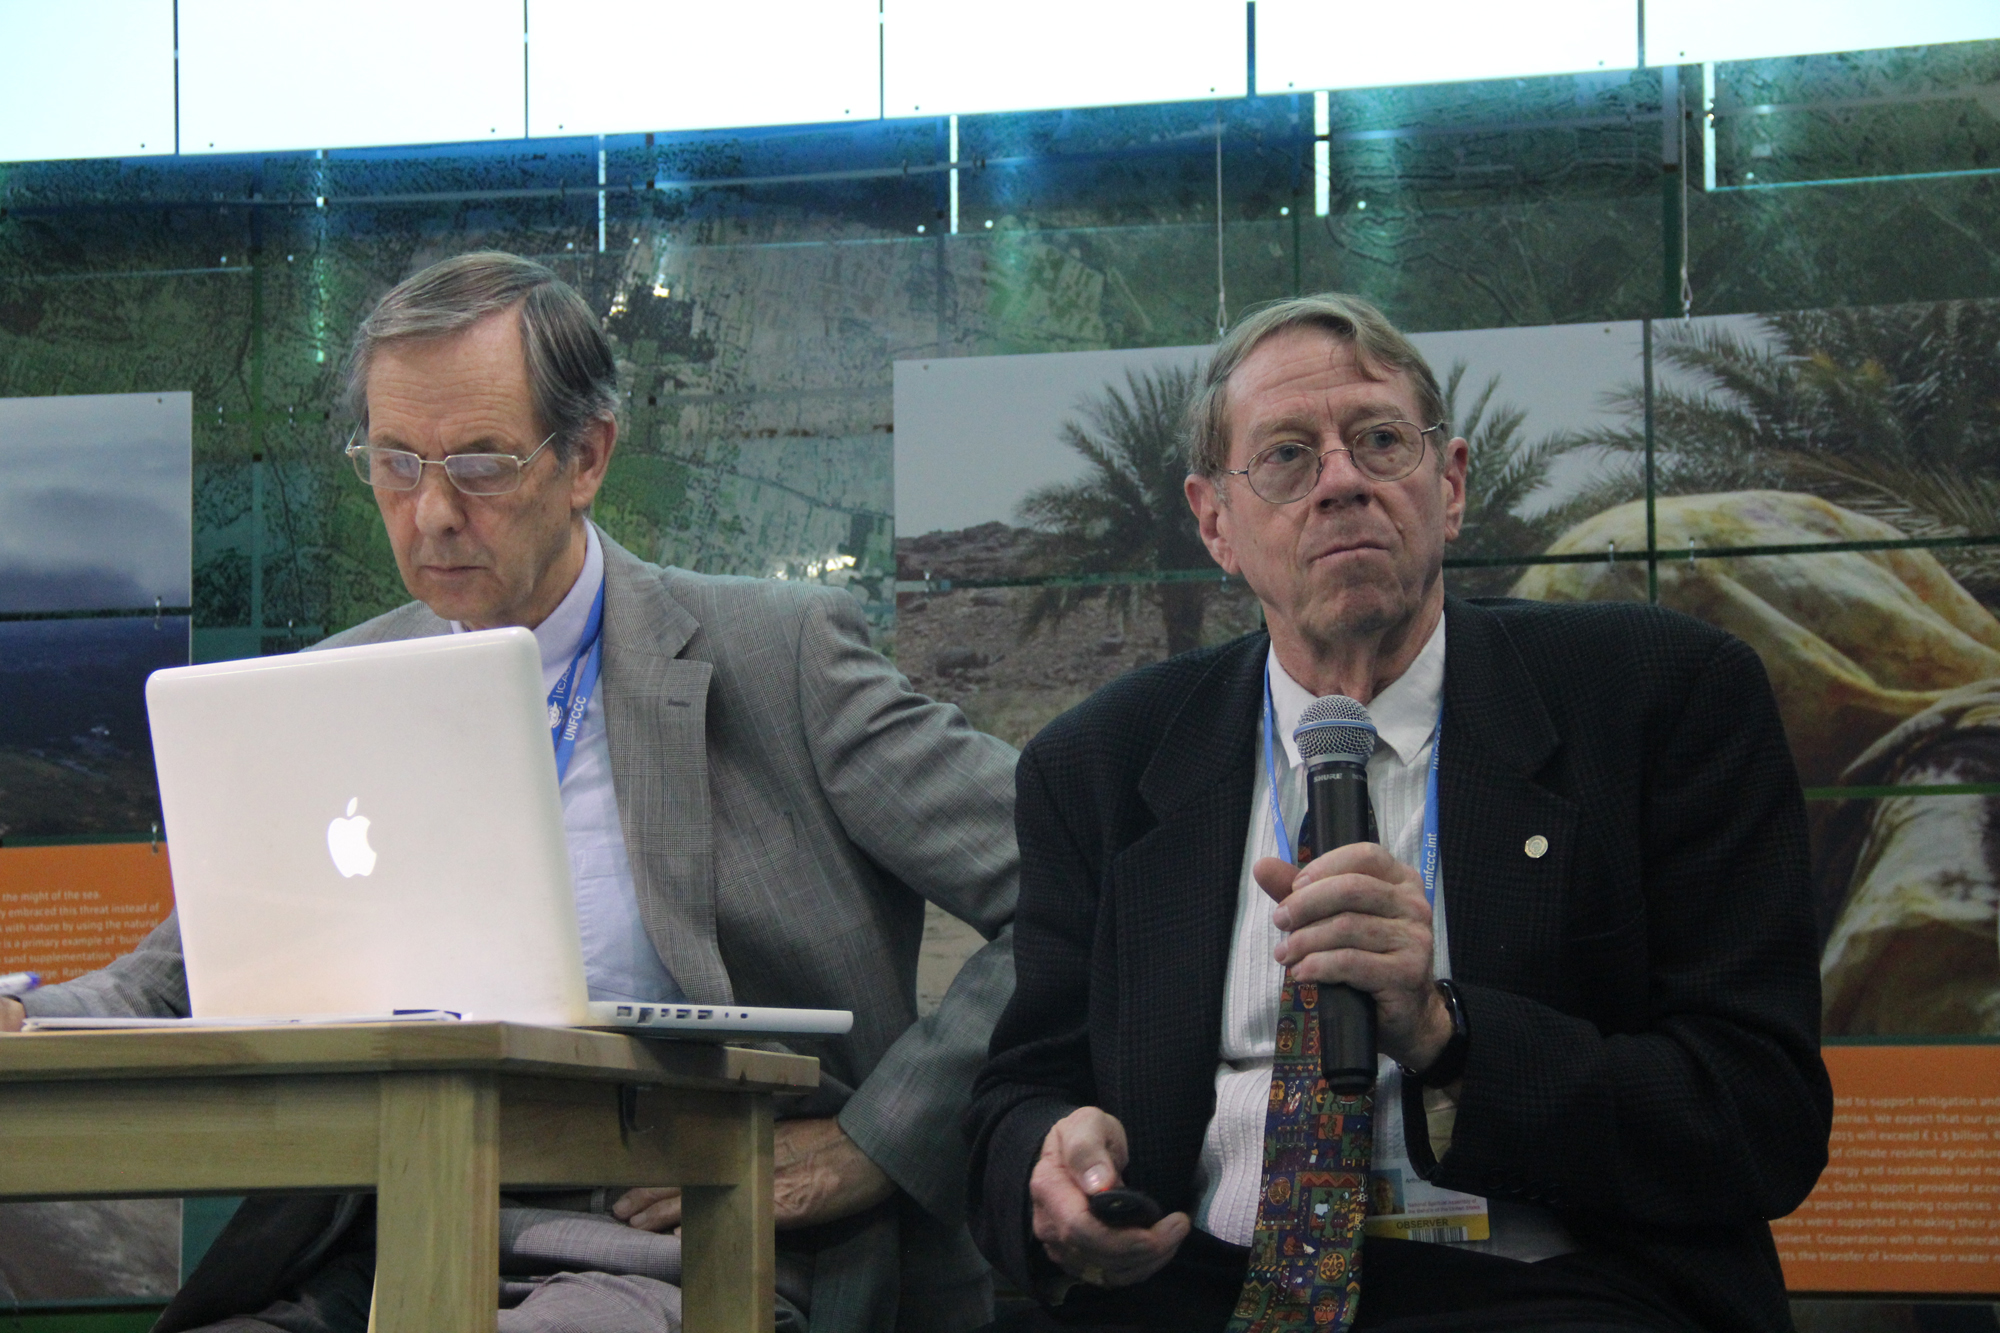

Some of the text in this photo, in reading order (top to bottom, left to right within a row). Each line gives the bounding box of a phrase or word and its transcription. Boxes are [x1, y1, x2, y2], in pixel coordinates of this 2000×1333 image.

[564, 696, 586, 740] UNFCCC
[1314, 773, 1342, 782] SHURE
[1424, 832, 1437, 890] unfccc.int
[2, 892, 18, 902] the
[20, 891, 49, 904] might
[51, 890, 62, 900] of
[64, 890, 80, 900] the
[8, 906, 57, 918] embraced
[59, 906, 78, 916] this
[80, 904, 109, 915] threat
[111, 902, 148, 914] instead
[149, 902, 160, 912] of
[4, 922, 26, 933] with
[28, 923, 60, 932] nature
[62, 921, 74, 932] by
[76, 920, 103, 932] using
[105, 920, 122, 930] the
[124, 918, 159, 929] natural
[4, 938, 12, 948] is
[14, 940, 20, 948] a
[22, 938, 59, 950] primary
[62, 936, 102, 947] example
[104, 934, 115, 945] of
[4, 954, 28, 964] sand
[1854, 1096, 1868, 1106] to
[1870, 1096, 1914, 1109] support
[1918, 1096, 1978, 1110] mitigation
[1874, 1114, 1892, 1124] We
[1894, 1114, 1934, 1126] expect
[1936, 1113, 1960, 1124] that
[1962, 1115, 1982, 1124] our
[1857, 1130, 1877, 1141] will
[1879, 1130, 1920, 1142] exceed
[1831, 1147, 1842, 1158] of
[1846, 1147, 1888, 1158] climate
[1890, 1147, 1937, 1158] resilient
[1862, 1165, 1884, 1176] and
[1887, 1165, 1953, 1176] sustainable
[1956, 1164, 1982, 1176] land
[1834, 1180, 1868, 1192] Dutch
[1870, 1182, 1916, 1195] support
[1918, 1182, 1970, 1195] provided
[1815, 1200, 1854, 1212] people
[1856, 1200, 1868, 1210] in
[1870, 1199, 1934, 1213] developing
[1396, 1218, 1448, 1230] OBSERVER
[1806, 1218, 1834, 1228] were
[1836, 1218, 1896, 1230] supported
[1898, 1218, 1910, 1228] in
[1912, 1218, 1956, 1231] making
[1958, 1218, 1986, 1228] their
[1816, 1234, 1888, 1246] Cooperation
[1889, 1234, 1914, 1245] with
[1916, 1234, 1948, 1246] other
[1798, 1250, 1818, 1262] the
[1820, 1250, 1865, 1262] transfer
[1868, 1250, 1880, 1262] of
[1882, 1250, 1938, 1262] knowhow
[1940, 1252, 1956, 1262] on
[1957, 1252, 1990, 1264] water
